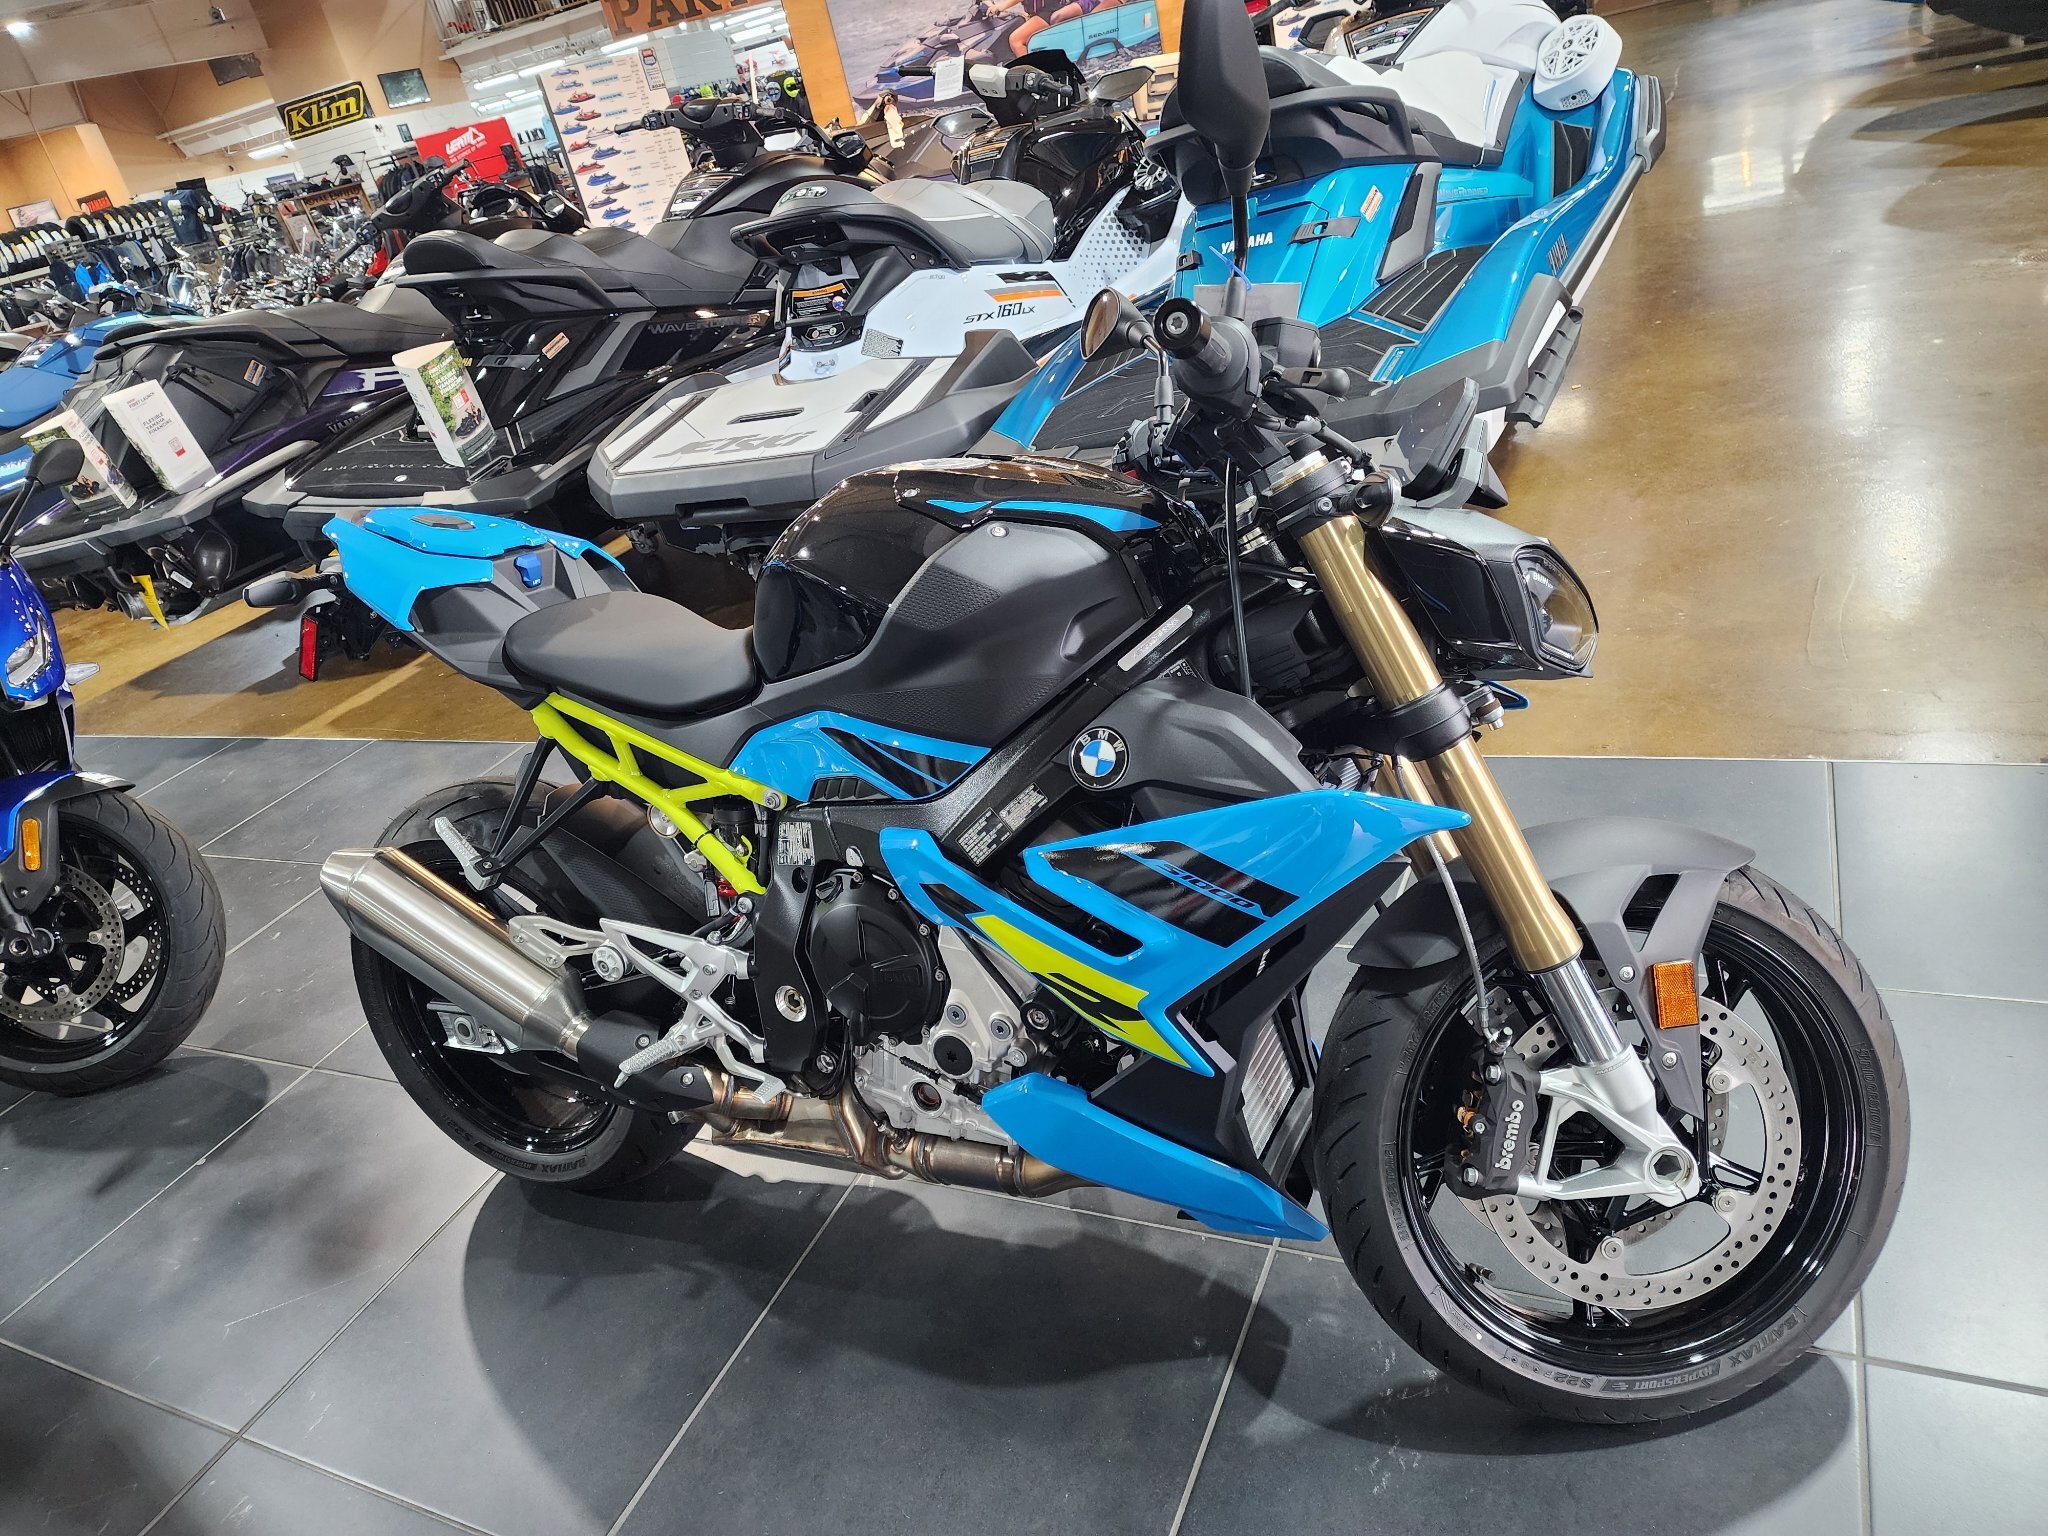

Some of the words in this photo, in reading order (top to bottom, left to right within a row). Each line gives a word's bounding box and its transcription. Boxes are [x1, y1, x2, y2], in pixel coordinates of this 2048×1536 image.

[289, 96, 359, 132] Klim
[1222, 232, 1273, 254] YAAHA
[1080, 730, 1125, 752] BMW
[1494, 1100, 1524, 1170] brembo
